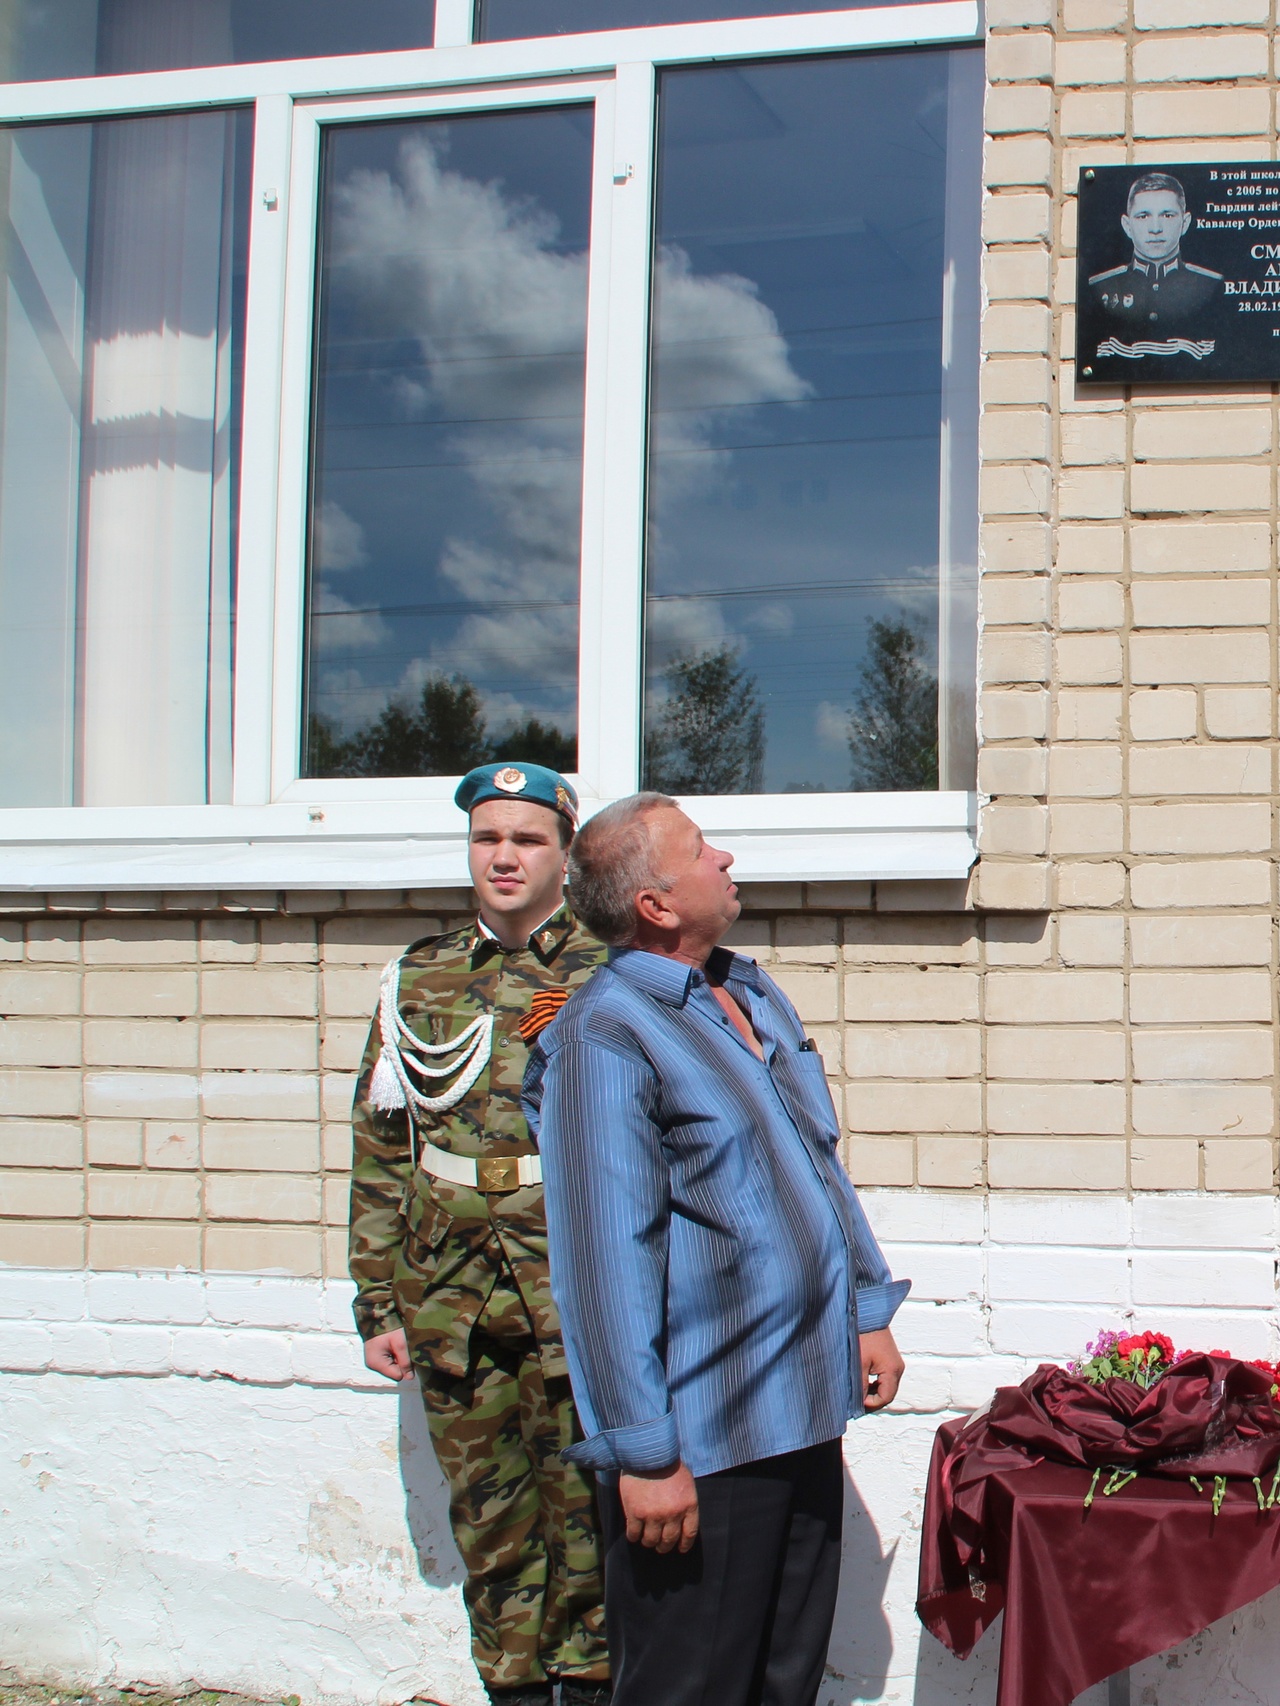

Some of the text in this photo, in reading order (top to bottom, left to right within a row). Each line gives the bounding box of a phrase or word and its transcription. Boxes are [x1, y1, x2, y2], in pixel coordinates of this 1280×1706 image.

[1210, 171, 1218, 180] В
[1222, 170, 1246, 180] этой
[1236, 186, 1261, 195] 2005
[1206, 203, 1254, 214] Гвардии
[1197, 219, 1244, 230] Кавалер
